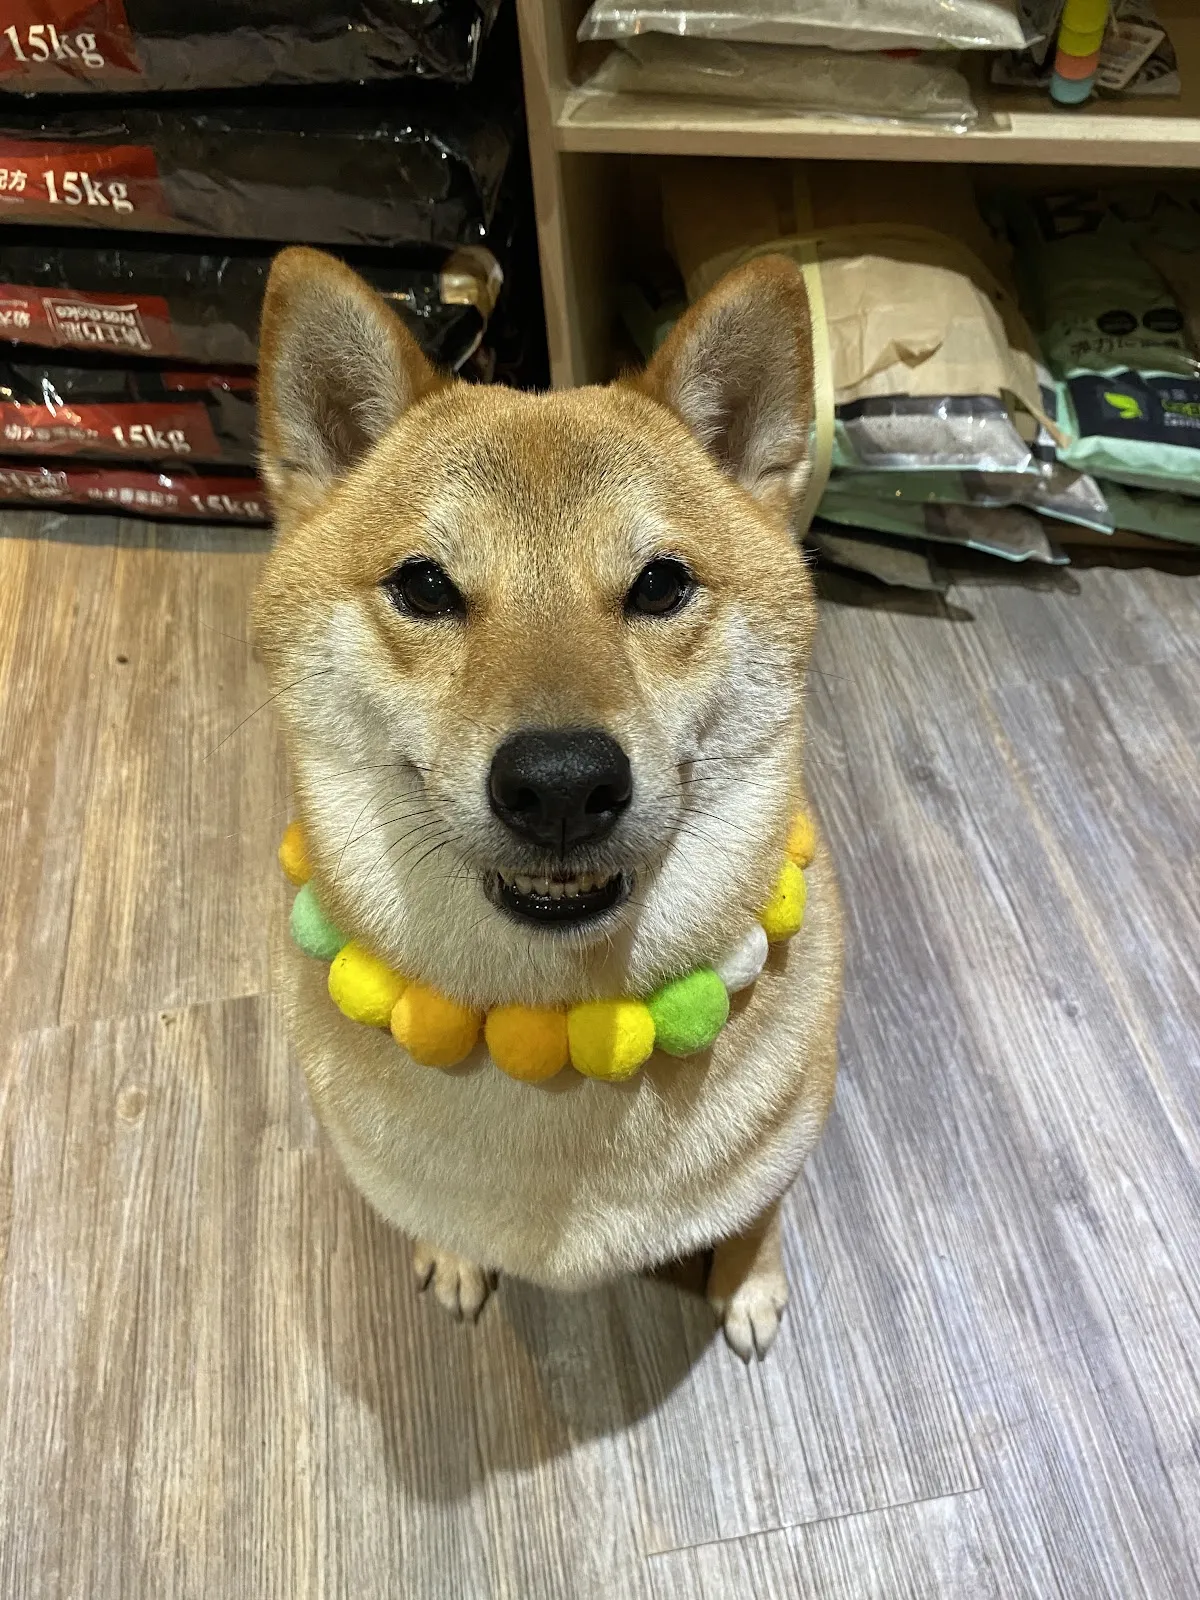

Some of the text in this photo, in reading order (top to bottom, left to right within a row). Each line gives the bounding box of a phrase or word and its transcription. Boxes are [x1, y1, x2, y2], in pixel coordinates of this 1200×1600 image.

[4, 24, 105, 68] 15kg
[43, 170, 134, 214] 15kg
[112, 424, 191, 453] 15kg
